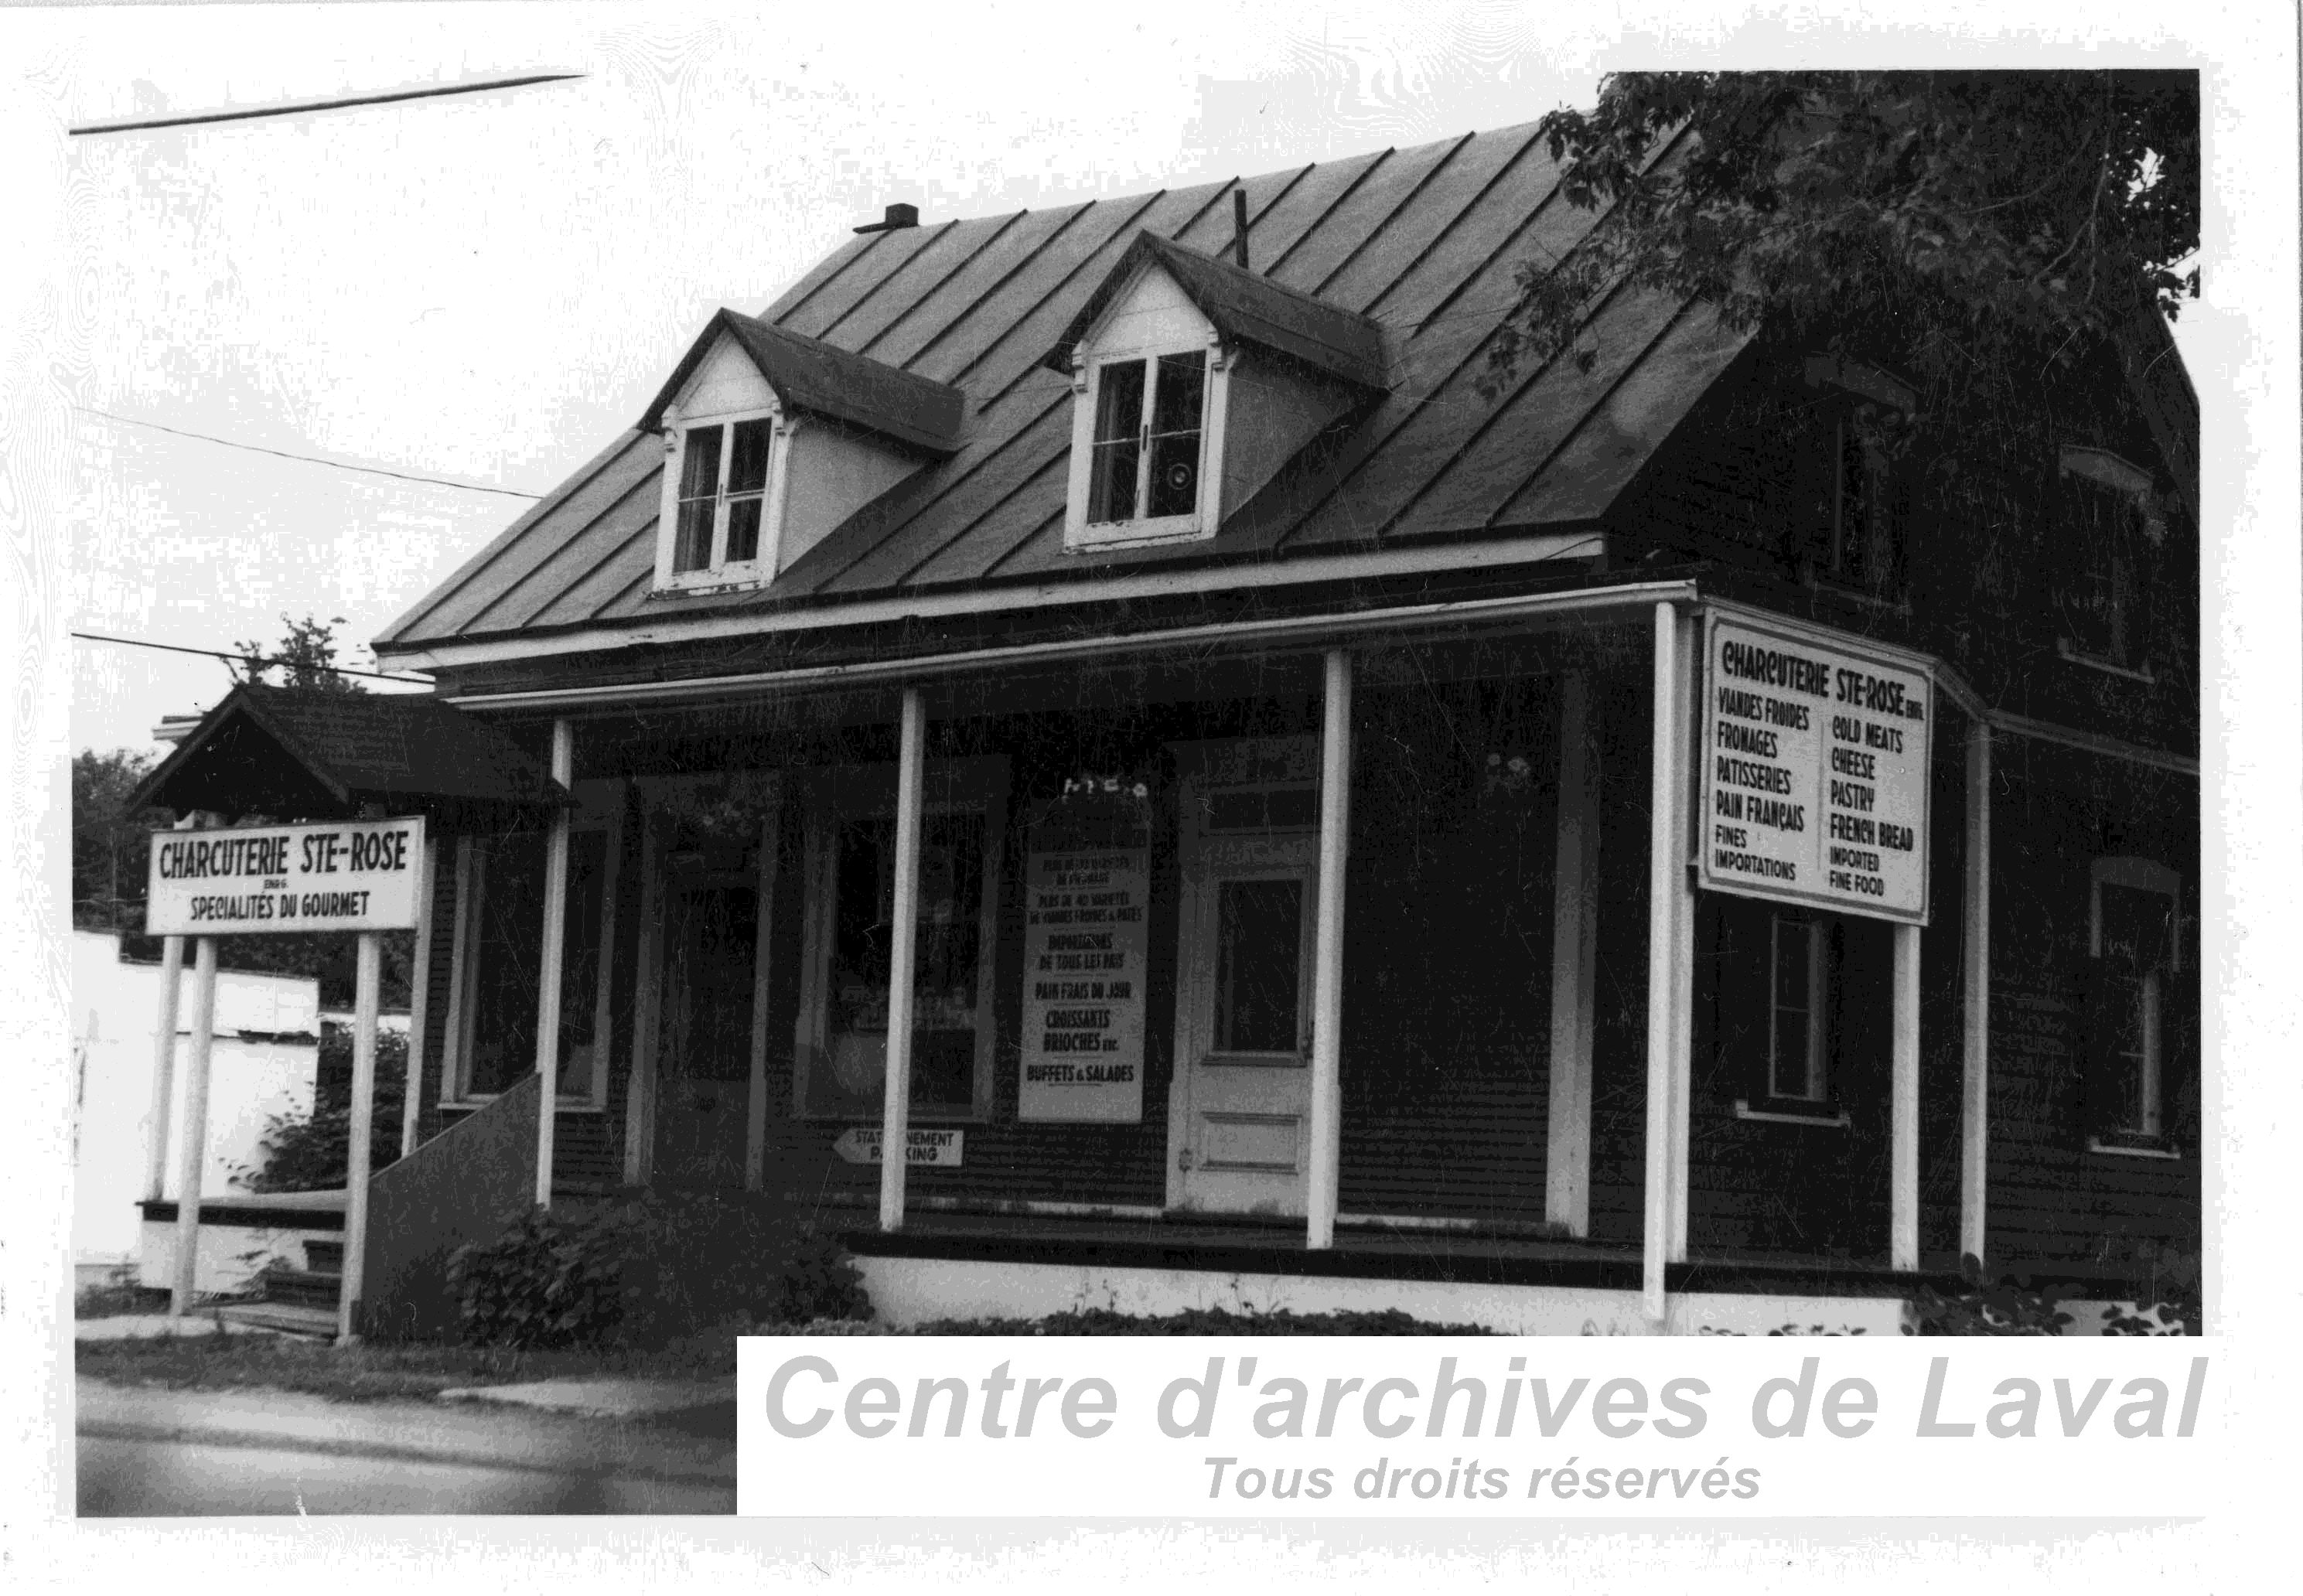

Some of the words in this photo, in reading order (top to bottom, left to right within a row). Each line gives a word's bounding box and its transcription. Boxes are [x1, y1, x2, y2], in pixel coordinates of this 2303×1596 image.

[1722, 640, 1830, 697] CHARCUTERIE
[1837, 667, 1905, 716] STE-ROSE
[1718, 687, 1763, 721] VIANDES
[1766, 697, 1810, 731] FROIDES
[1718, 721, 1778, 759] FROMAGES
[1832, 715, 1861, 743] COLD
[1865, 722, 1903, 754] MEATS
[1717, 755, 1792, 795] PATISSERIES
[1831, 747, 1875, 780] CHEESE
[1717, 789, 1742, 820] PAIN
[1747, 795, 1804, 832] FRANÇAIS
[1830, 779, 1875, 812] PASTRY
[1715, 824, 1747, 848] FINES
[1830, 813, 1875, 844] FRENCH
[1878, 822, 1913, 851] BREAD
[159, 836, 290, 878] CHARCUTERIE
[301, 830, 409, 874] STE-ROSE
[1715, 848, 1796, 881] IMPORTATIONS
[1830, 846, 1879, 872] IMPORTED
[1830, 870, 1851, 892] FINE
[1854, 875, 1884, 896] FOOD
[280, 894, 298, 918] DU
[302, 891, 370, 917] GOURMET
[1035, 981, 1059, 1000] PAIN
[1061, 981, 1090, 1000] FRAIS
[1090, 981, 1104, 999] DU
[1046, 1009, 1111, 1028] CROISSANTS
[1043, 1032, 1101, 1052] BRIOCHES
[1027, 1065, 1074, 1082] BUFFETS
[1086, 1064, 1134, 1082] SALADES
